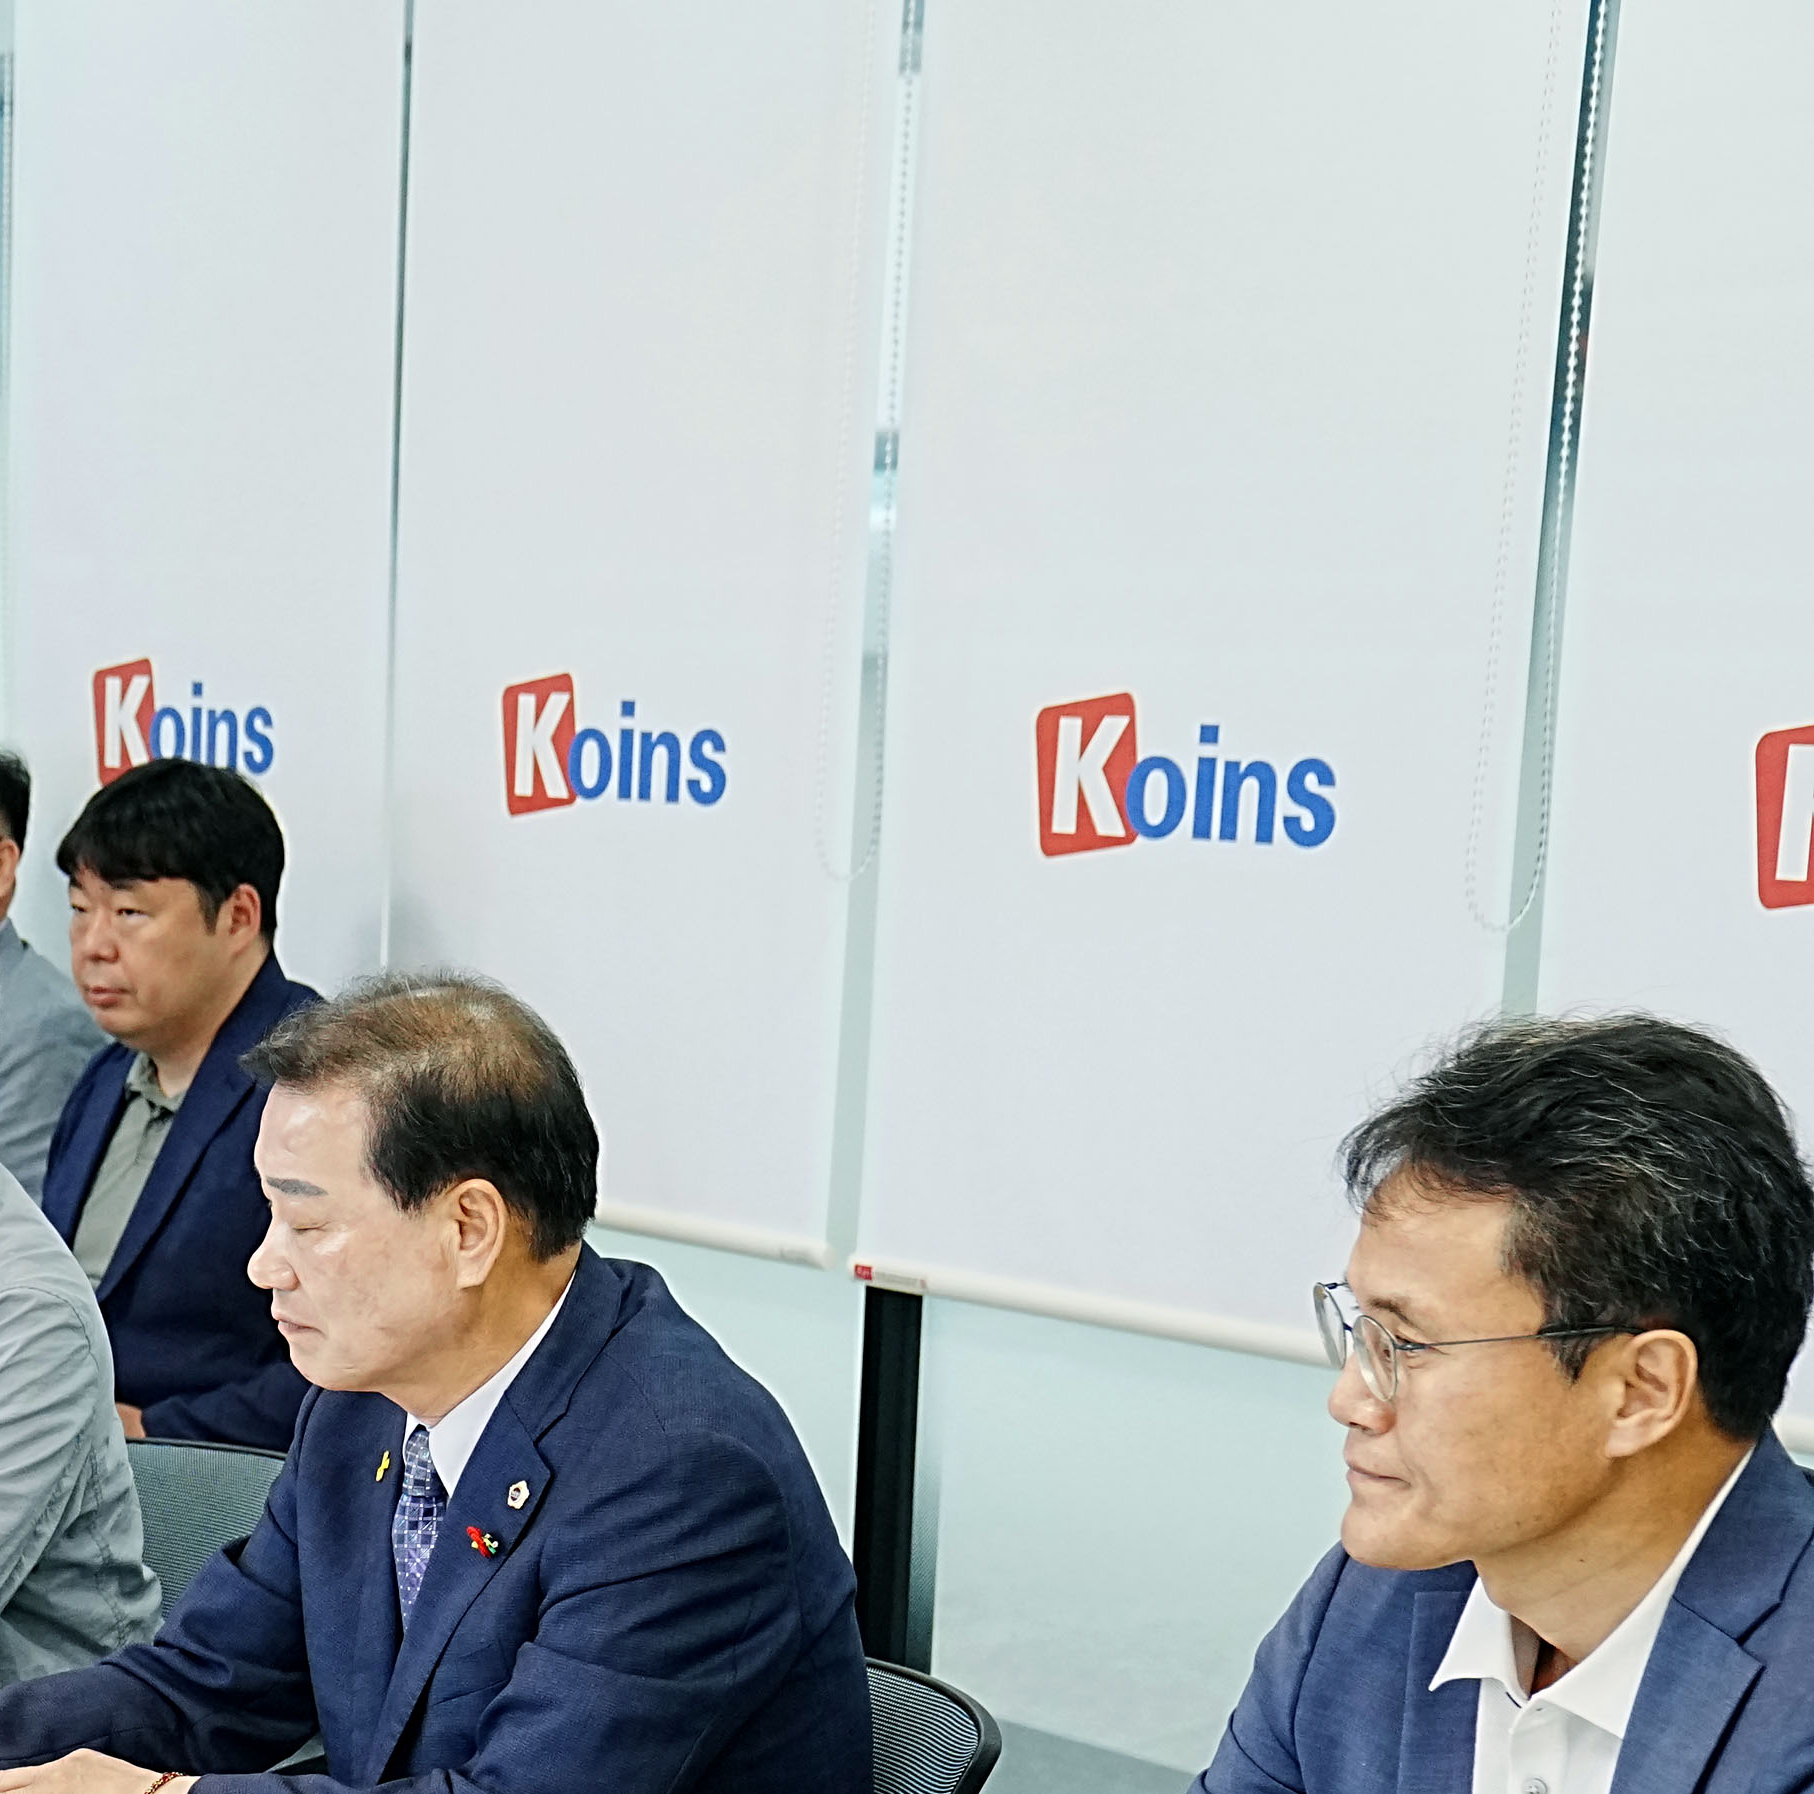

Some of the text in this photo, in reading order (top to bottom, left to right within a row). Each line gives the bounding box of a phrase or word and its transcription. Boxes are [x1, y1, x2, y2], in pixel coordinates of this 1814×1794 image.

[103, 674, 274, 776] Koins
[513, 690, 728, 808] Koins
[1049, 713, 1337, 850] Koins
